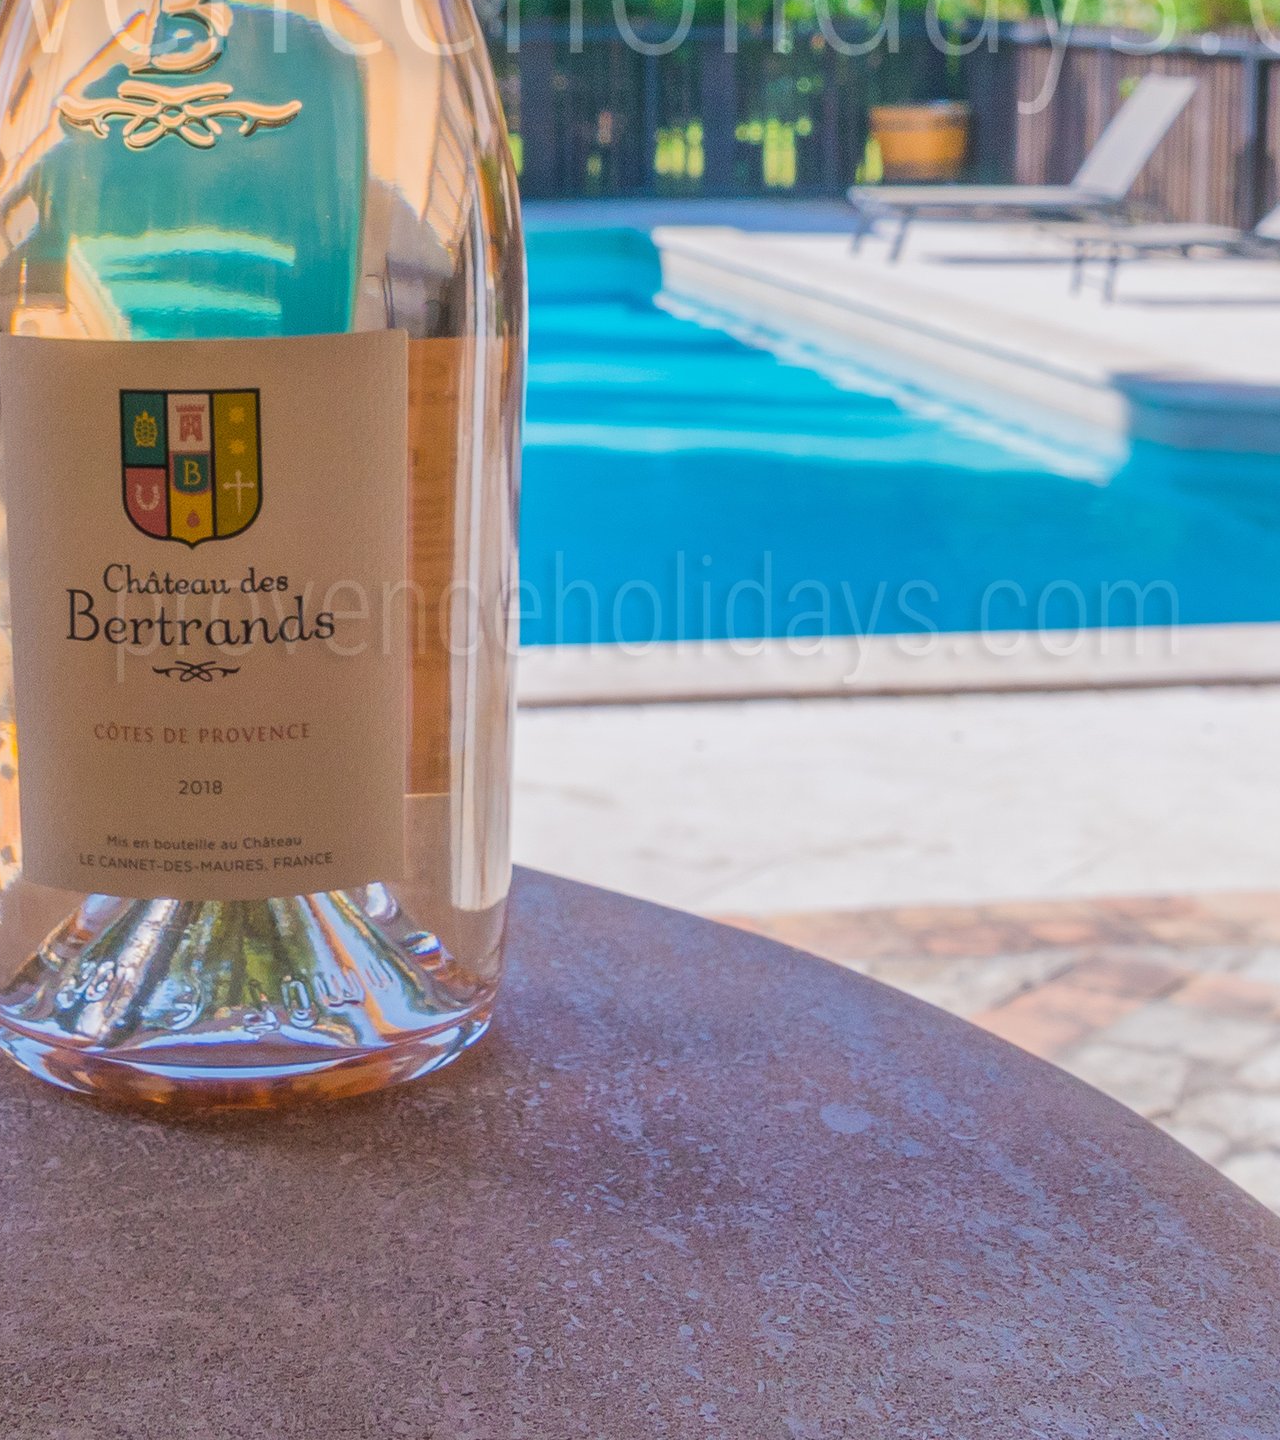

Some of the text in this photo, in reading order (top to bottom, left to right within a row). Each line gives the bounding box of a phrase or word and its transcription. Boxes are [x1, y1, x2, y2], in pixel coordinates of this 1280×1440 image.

[182, 459, 202, 486] B
[102, 563, 289, 595] Château des
[65, 588, 336, 647] Bertrands
[93, 721, 311, 744] CÔTES DE PROVENCE
[178, 779, 224, 796] 2018
[106, 834, 303, 851] Mis en bouteille au Château
[78, 852, 95, 867] LE
[272, 850, 334, 870] FRANCE
